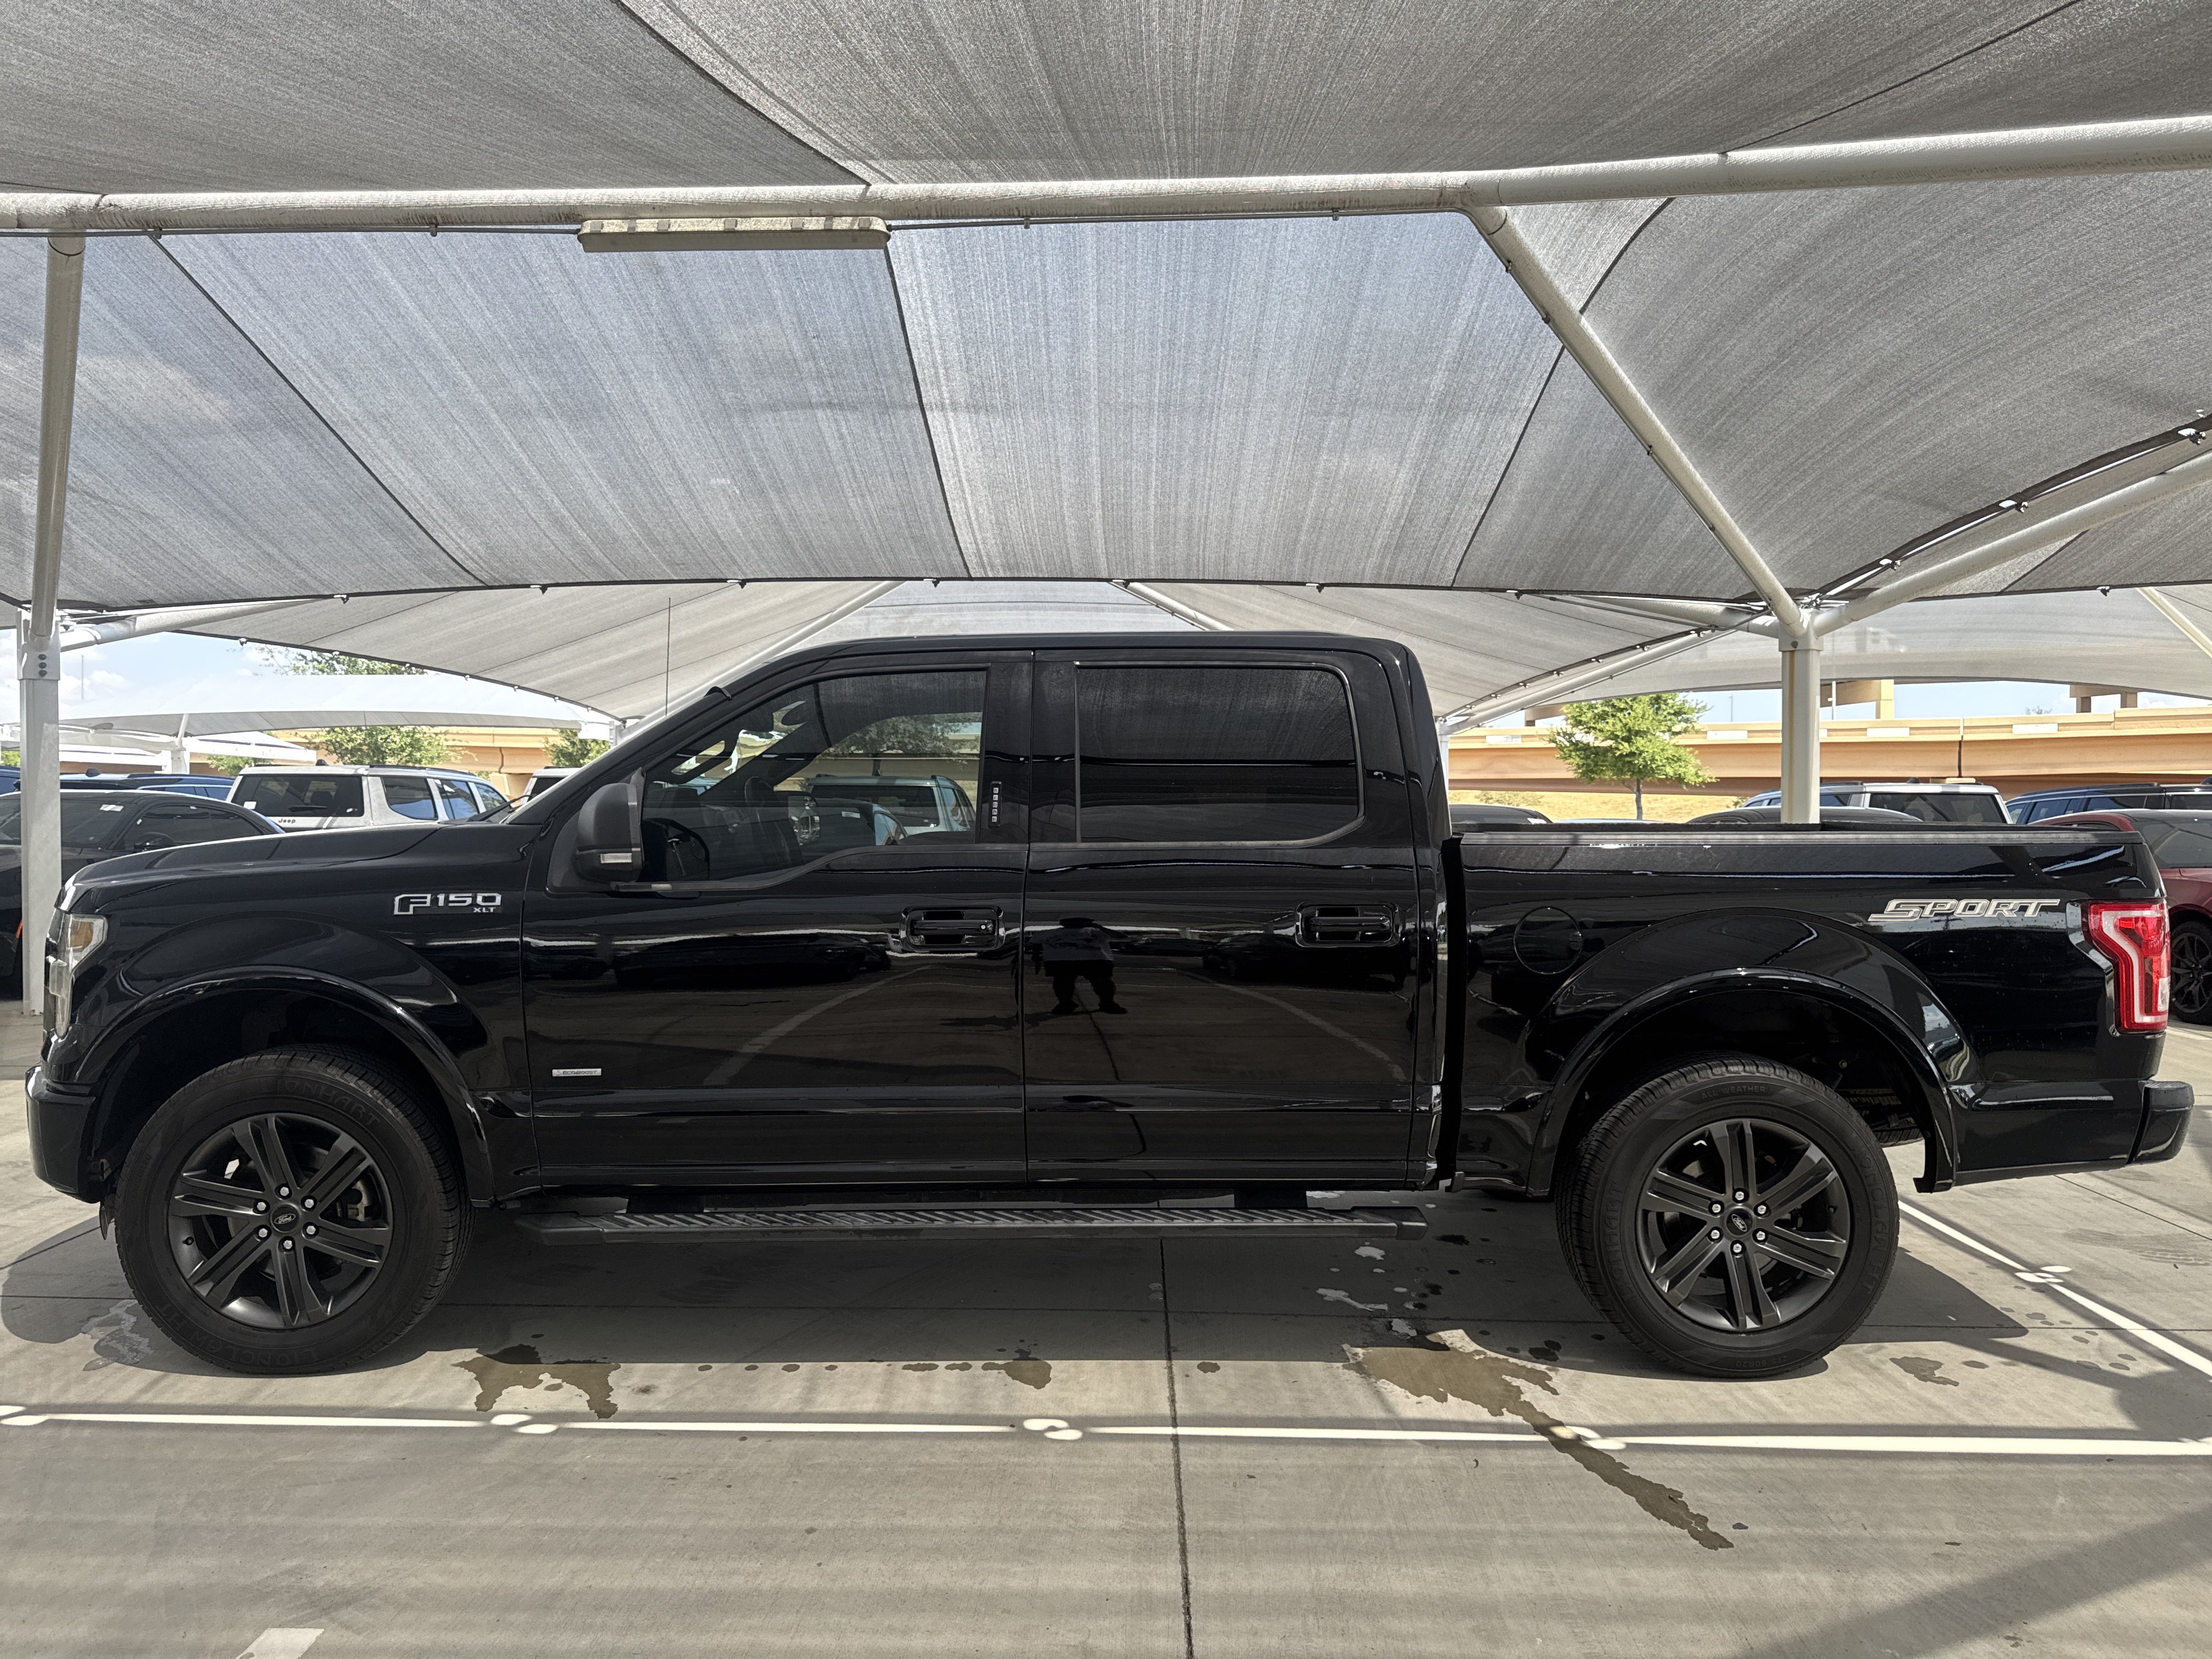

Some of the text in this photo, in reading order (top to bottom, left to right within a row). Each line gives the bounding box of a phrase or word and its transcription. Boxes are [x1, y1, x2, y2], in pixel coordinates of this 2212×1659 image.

[1867, 899, 2060, 922] SPORT
[1701, 1085, 1765, 1099] ALL WEATHER
[276, 1214, 294, 1224] Ford
